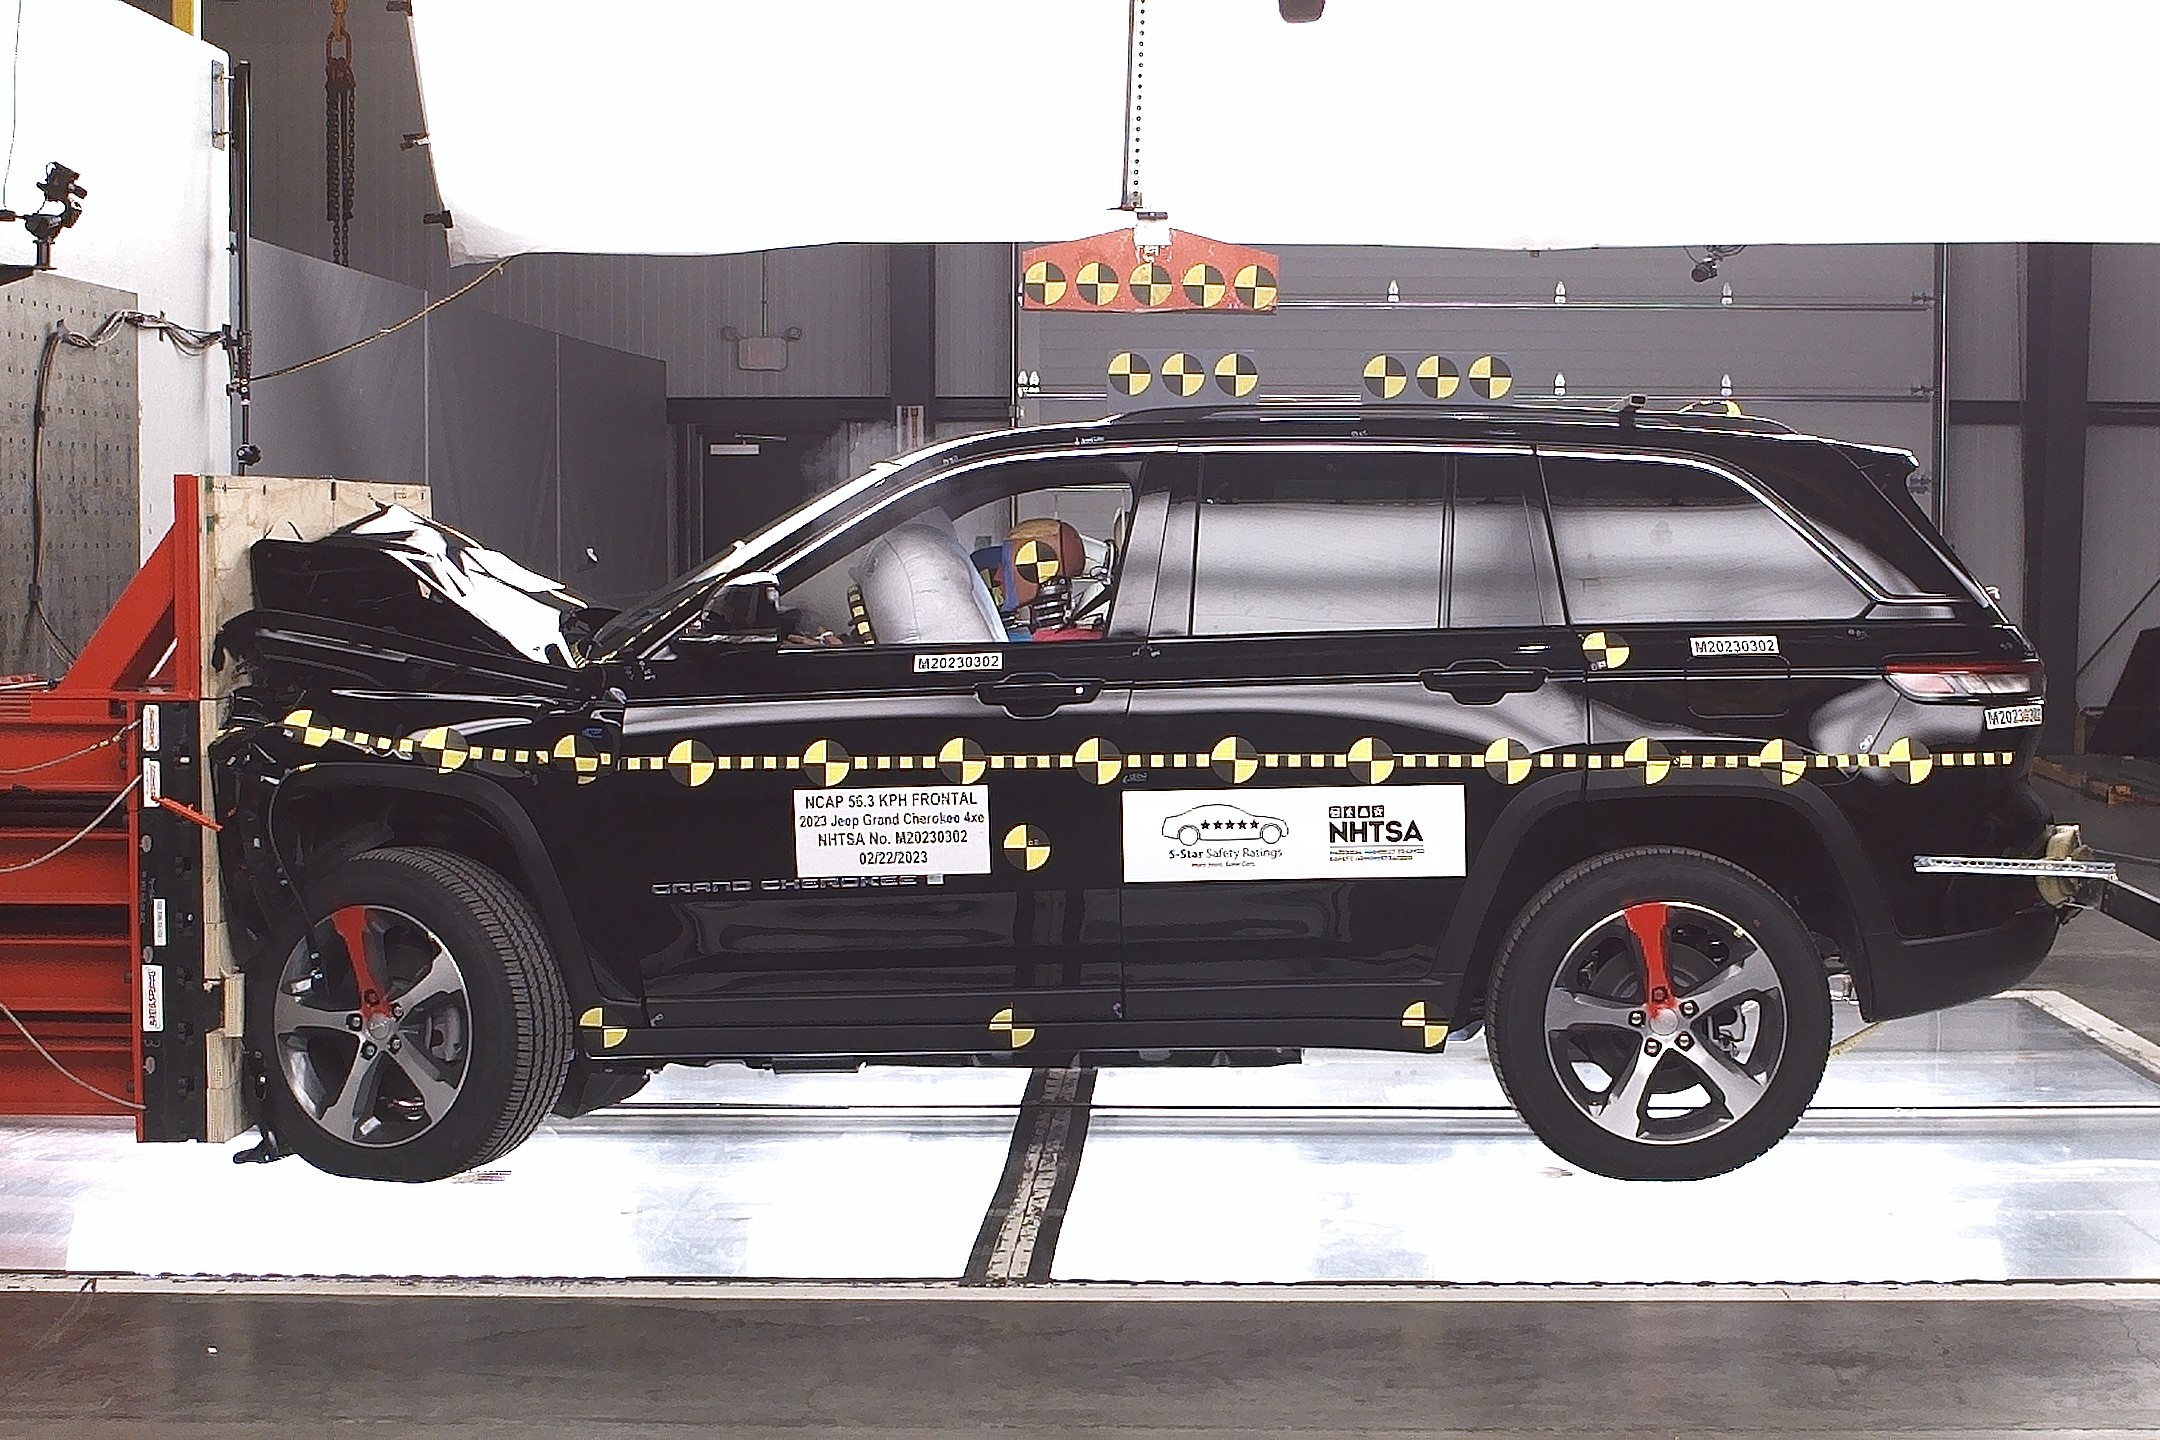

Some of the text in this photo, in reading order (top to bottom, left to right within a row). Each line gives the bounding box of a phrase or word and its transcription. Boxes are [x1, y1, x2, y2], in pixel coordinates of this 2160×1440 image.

[1695, 640, 1775, 653] M20230302
[919, 656, 999, 669] M20230302
[805, 792, 978, 809] NCAP 56.3 KPH FRONTAL
[800, 815, 827, 827] 2023
[831, 814, 859, 829] Jeep
[863, 812, 900, 826] Grand
[903, 812, 960, 825] Cherokee
[818, 829, 968, 846] NHTSA No. M20230302
[1329, 820, 1424, 843] NHTSA
[859, 851, 929, 865] 02/22/2023
[1206, 847, 1239, 860] Safety
[651, 880, 752, 894] GRAND
